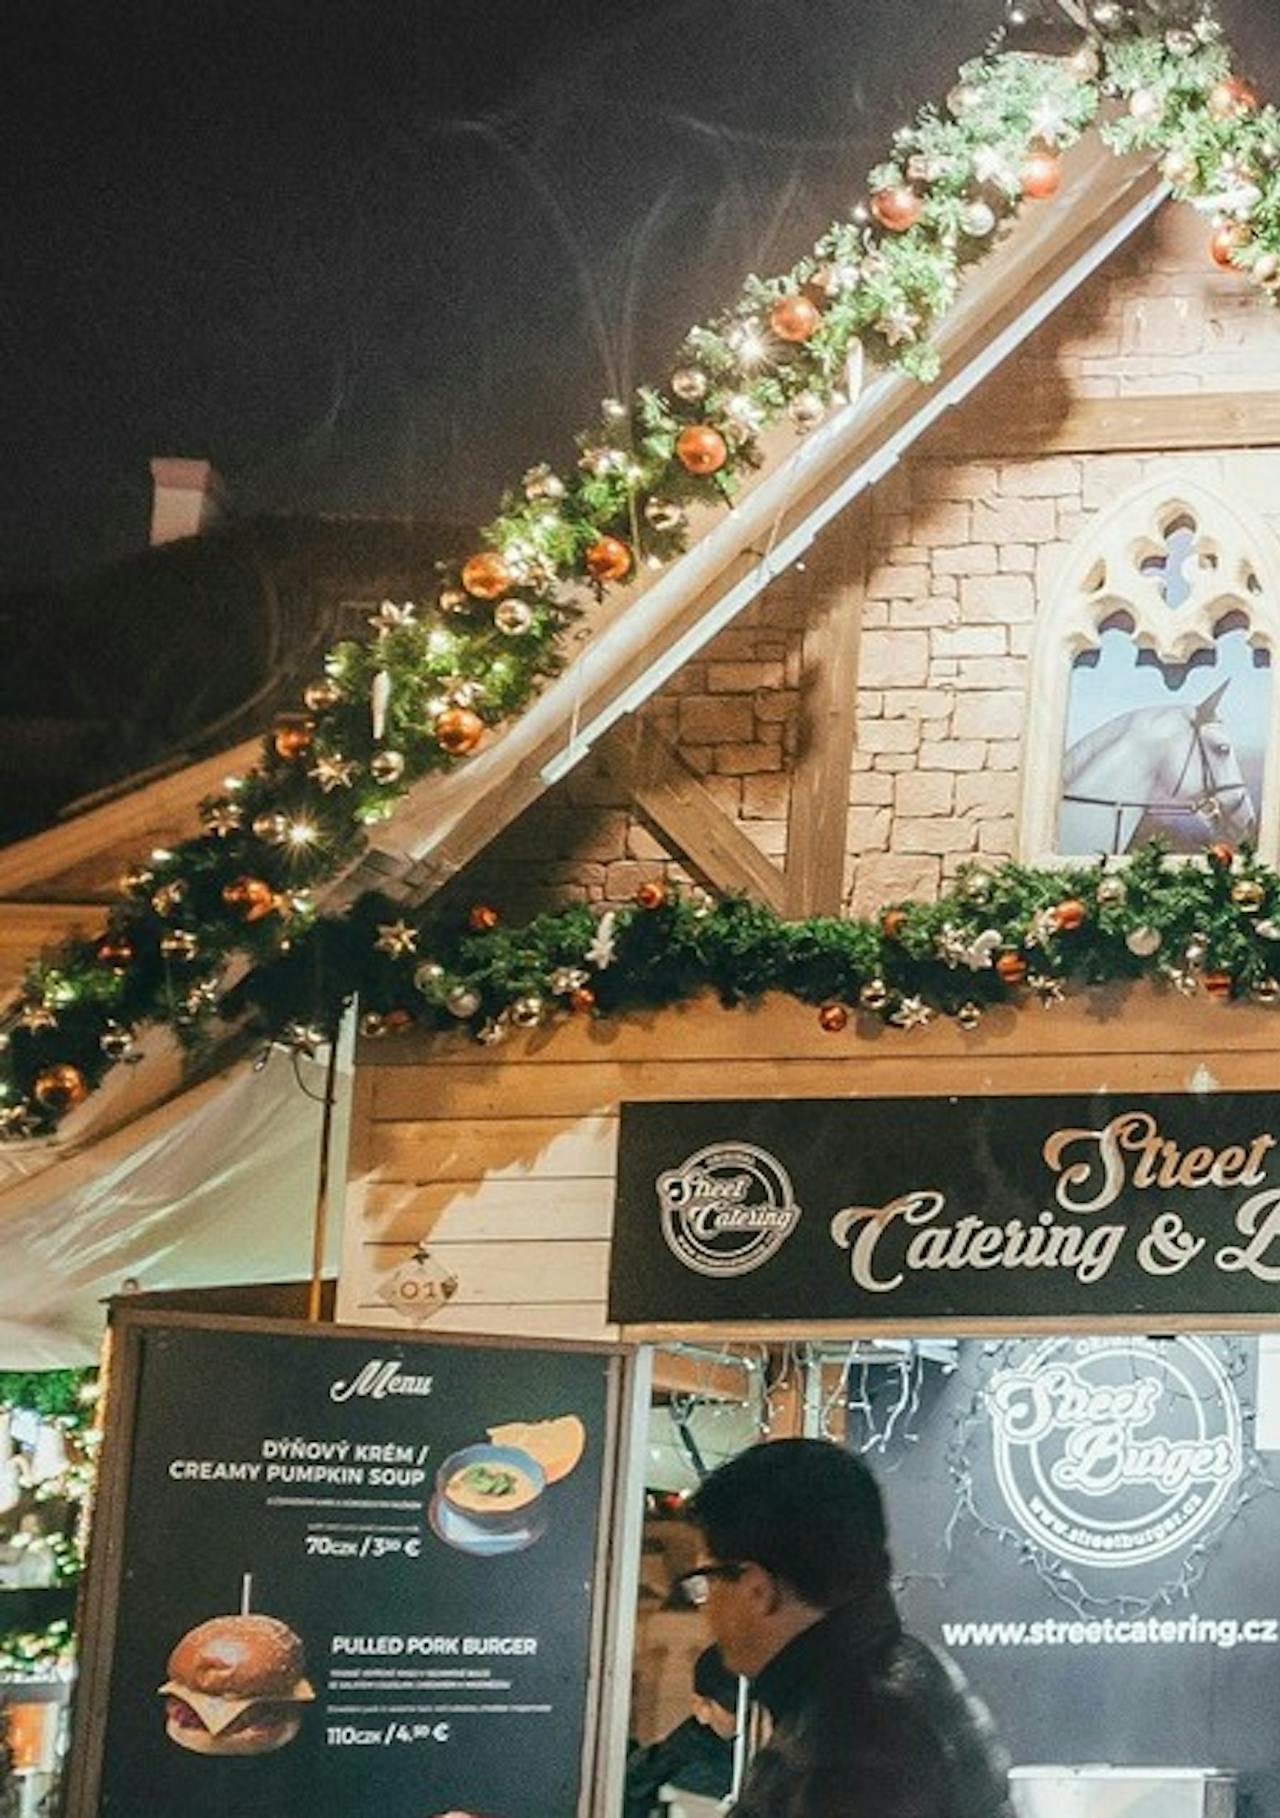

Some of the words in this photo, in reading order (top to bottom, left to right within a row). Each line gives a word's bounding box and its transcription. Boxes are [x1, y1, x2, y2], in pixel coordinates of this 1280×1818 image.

[1042, 1111, 1276, 1213] Street
[661, 1170, 748, 1205] Street
[687, 1200, 793, 1235] Catering
[831, 1190, 1127, 1293] Catering
[1137, 1213, 1205, 1276] &
[330, 1359, 433, 1402] Menu
[995, 1370, 1155, 1438] Street
[354, 1443, 413, 1464] KRÉM
[1055, 1425, 1232, 1490] Burger
[169, 1460, 261, 1482] CREAMY
[266, 1465, 363, 1485] PUMPKIN
[368, 1468, 425, 1486] SOUP
[332, 1636, 404, 1655] PULLED
[406, 1637, 459, 1655] PORK
[462, 1638, 538, 1655] BURGER
[941, 1613, 1279, 1648] www.streetcatering.cz
